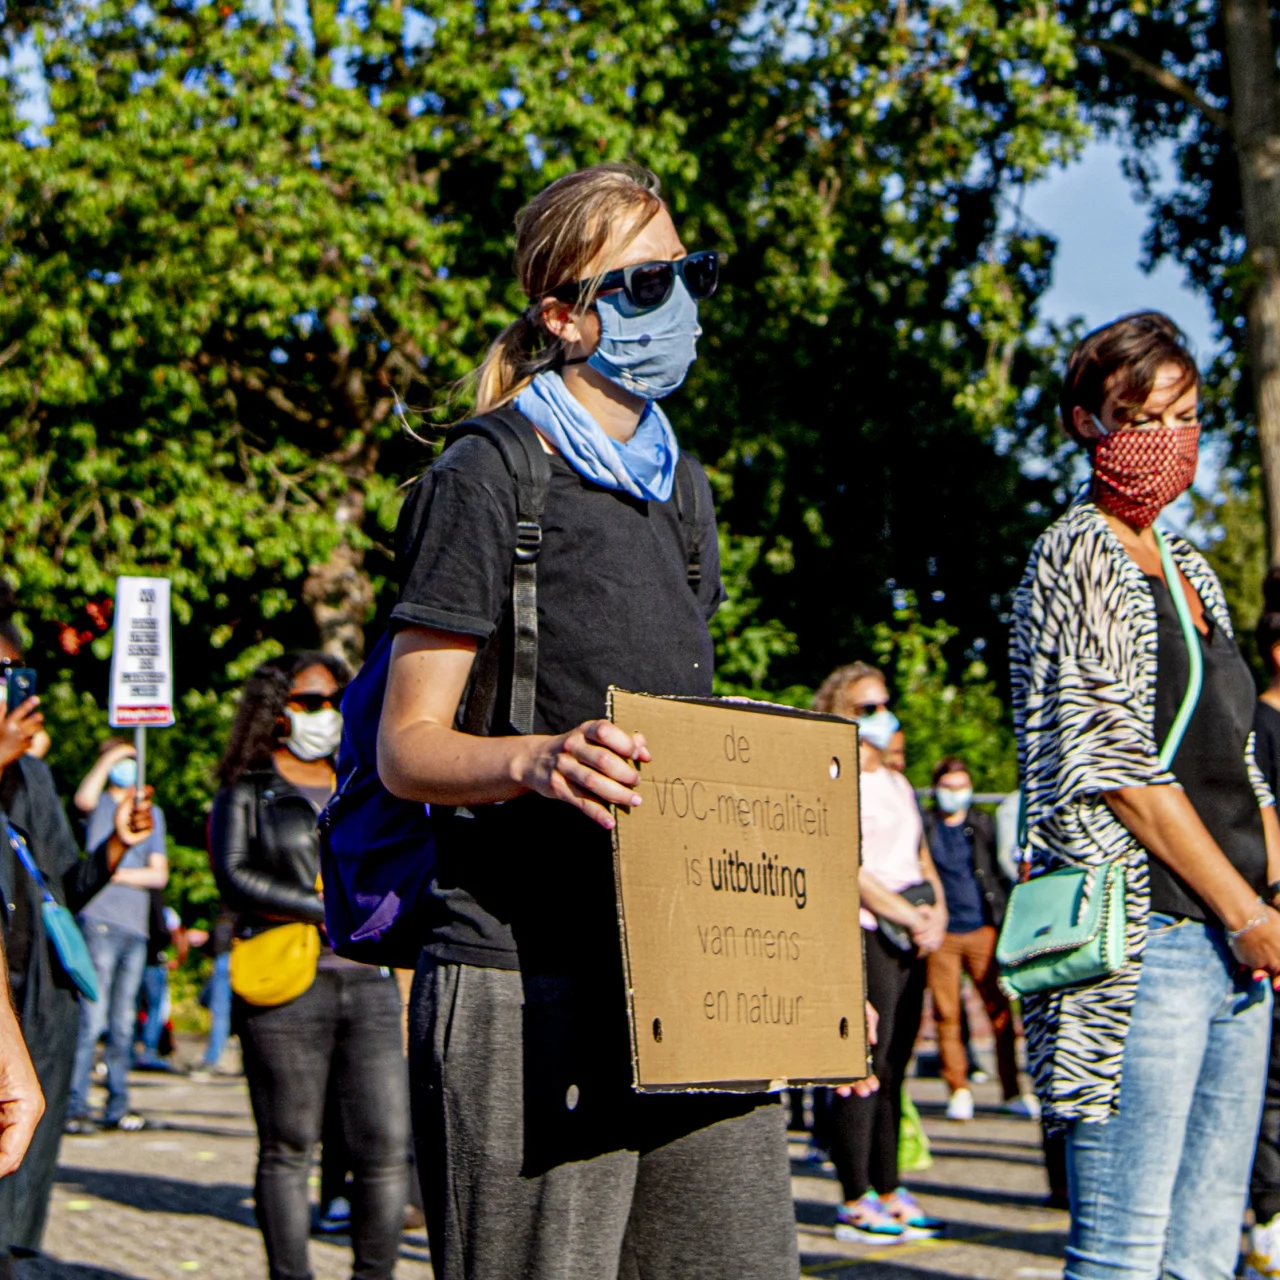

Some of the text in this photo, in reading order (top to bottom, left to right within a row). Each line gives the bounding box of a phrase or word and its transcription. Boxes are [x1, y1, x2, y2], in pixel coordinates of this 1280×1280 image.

[723, 724, 751, 764] de
[651, 775, 830, 838] VOC-mentaliteit
[683, 844, 808, 910] is uitbuiting
[697, 924, 801, 962] van mens
[703, 985, 804, 1027] en natuur
